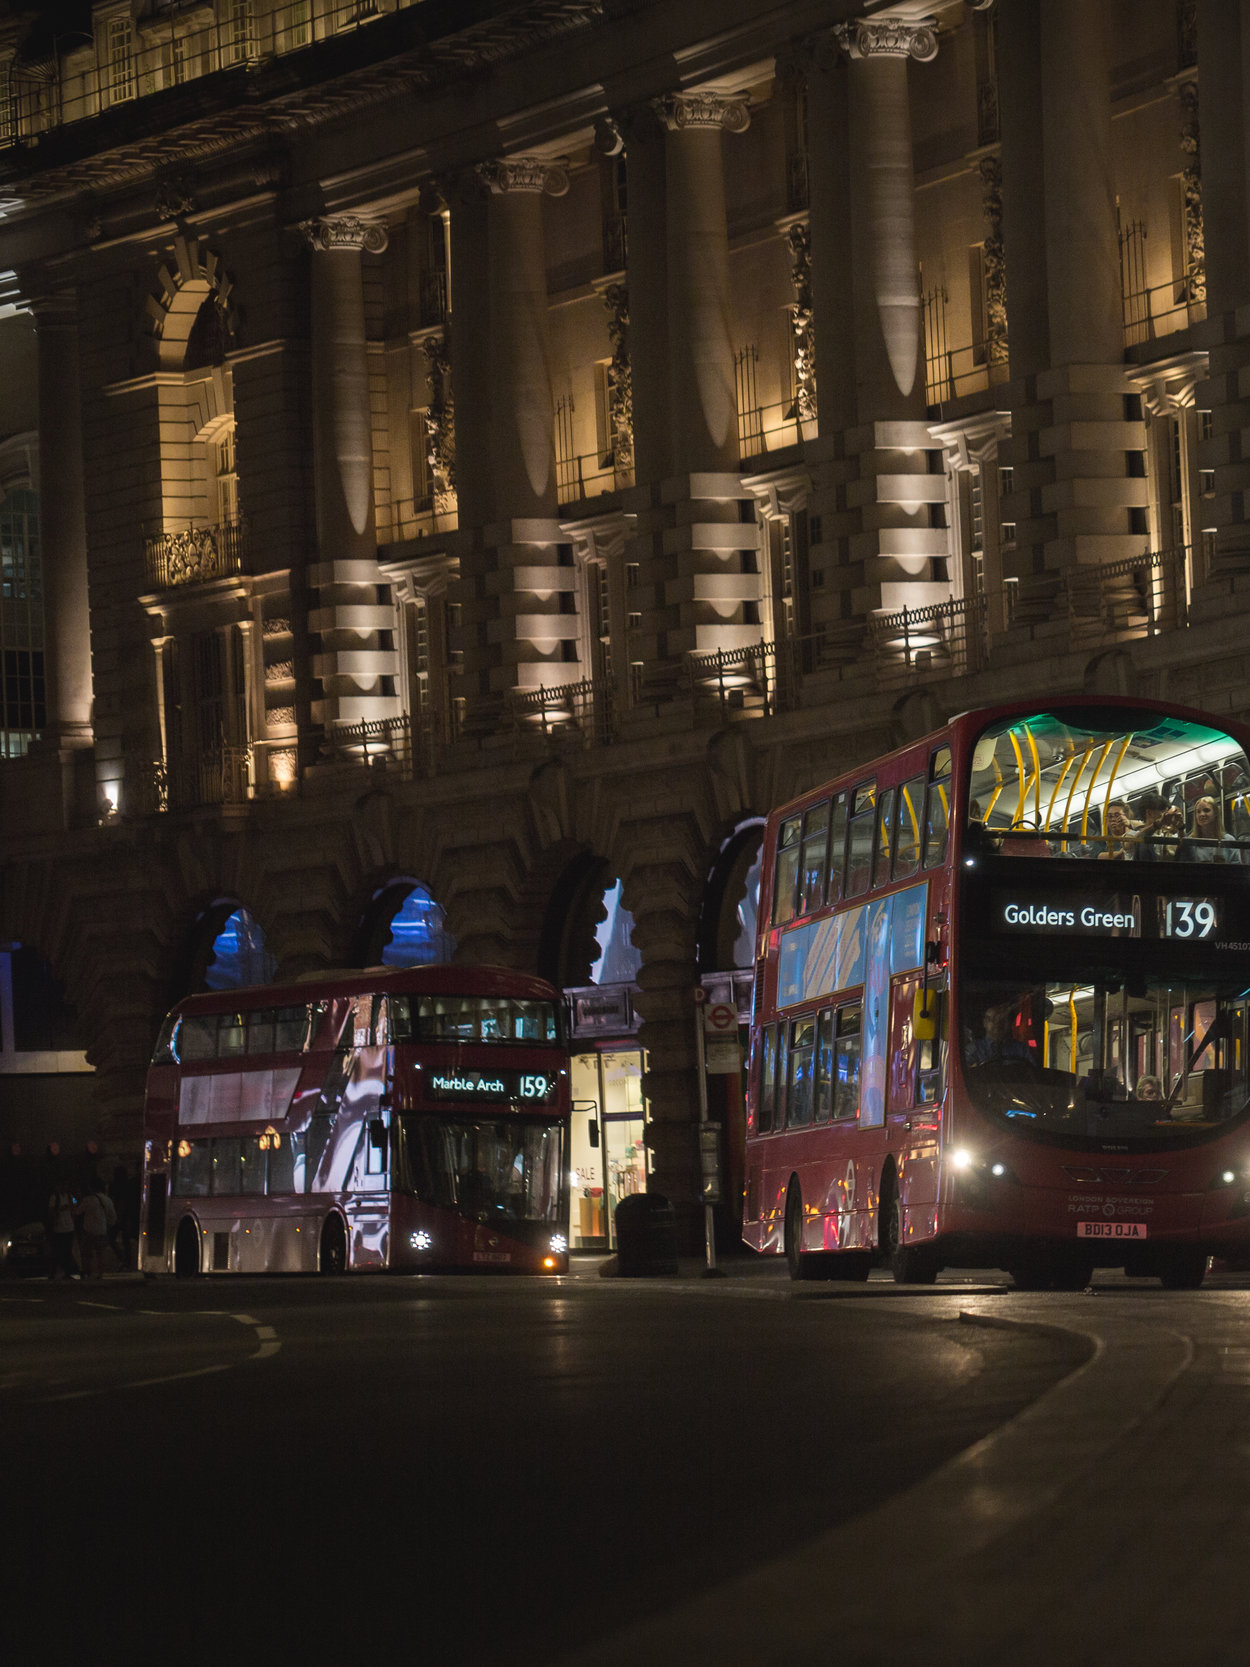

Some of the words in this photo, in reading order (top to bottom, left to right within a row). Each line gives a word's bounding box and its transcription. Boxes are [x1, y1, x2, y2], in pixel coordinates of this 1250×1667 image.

[1004, 904, 1075, 926] Golders
[1080, 907, 1136, 929] Green
[1166, 901, 1215, 938] 139
[432, 1076, 474, 1091] Marble
[476, 1078, 505, 1092] Arch
[519, 1074, 548, 1098] 159
[576, 1167, 595, 1181] SALE
[1068, 1194, 1104, 1203] LONDON
[1067, 1204, 1100, 1213] RATP
[1117, 1206, 1153, 1215] GROUP
